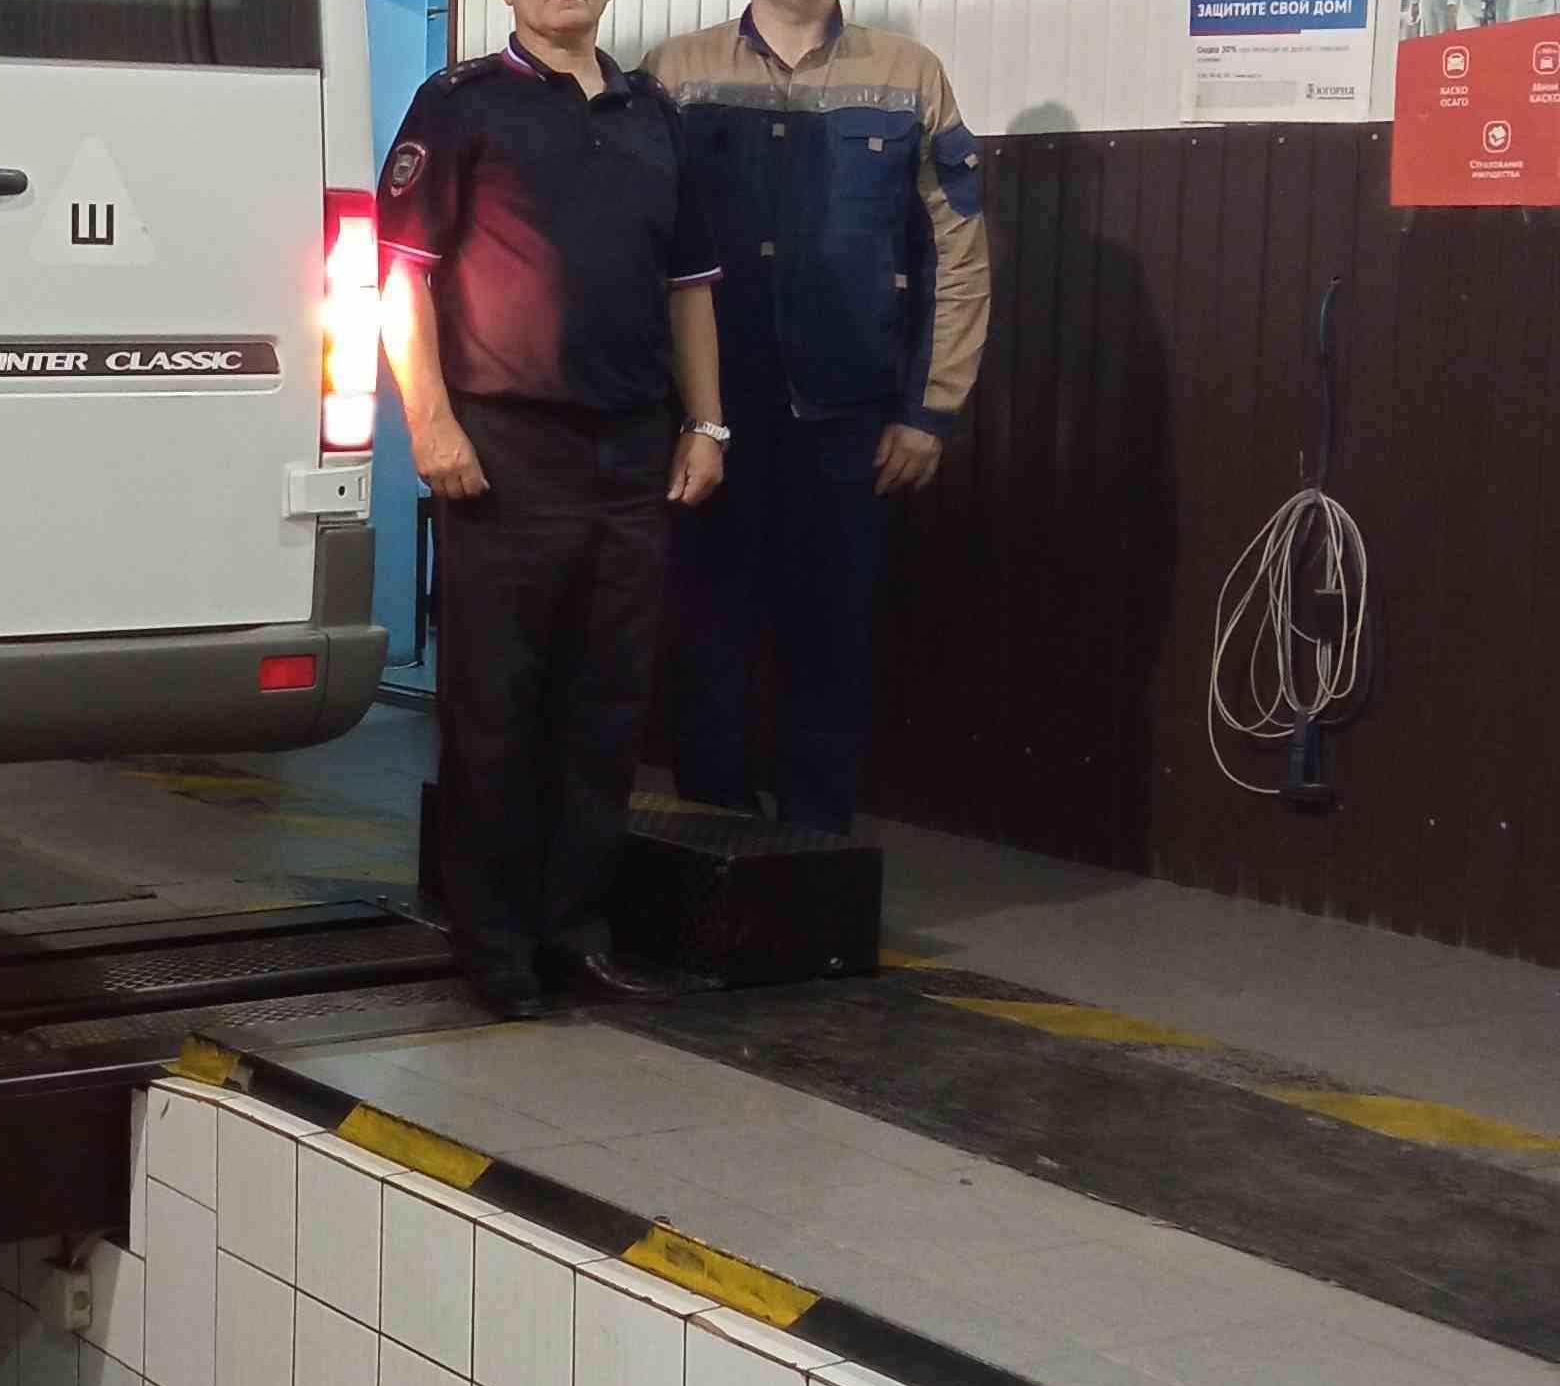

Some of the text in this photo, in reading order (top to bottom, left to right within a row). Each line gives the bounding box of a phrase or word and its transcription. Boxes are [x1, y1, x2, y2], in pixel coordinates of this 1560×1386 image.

[1197, 1, 1267, 19] ЗАЩИТИТЕ
[1312, 0, 1353, 16] ДОМ!
[104, 350, 242, 371] CLASSIC
